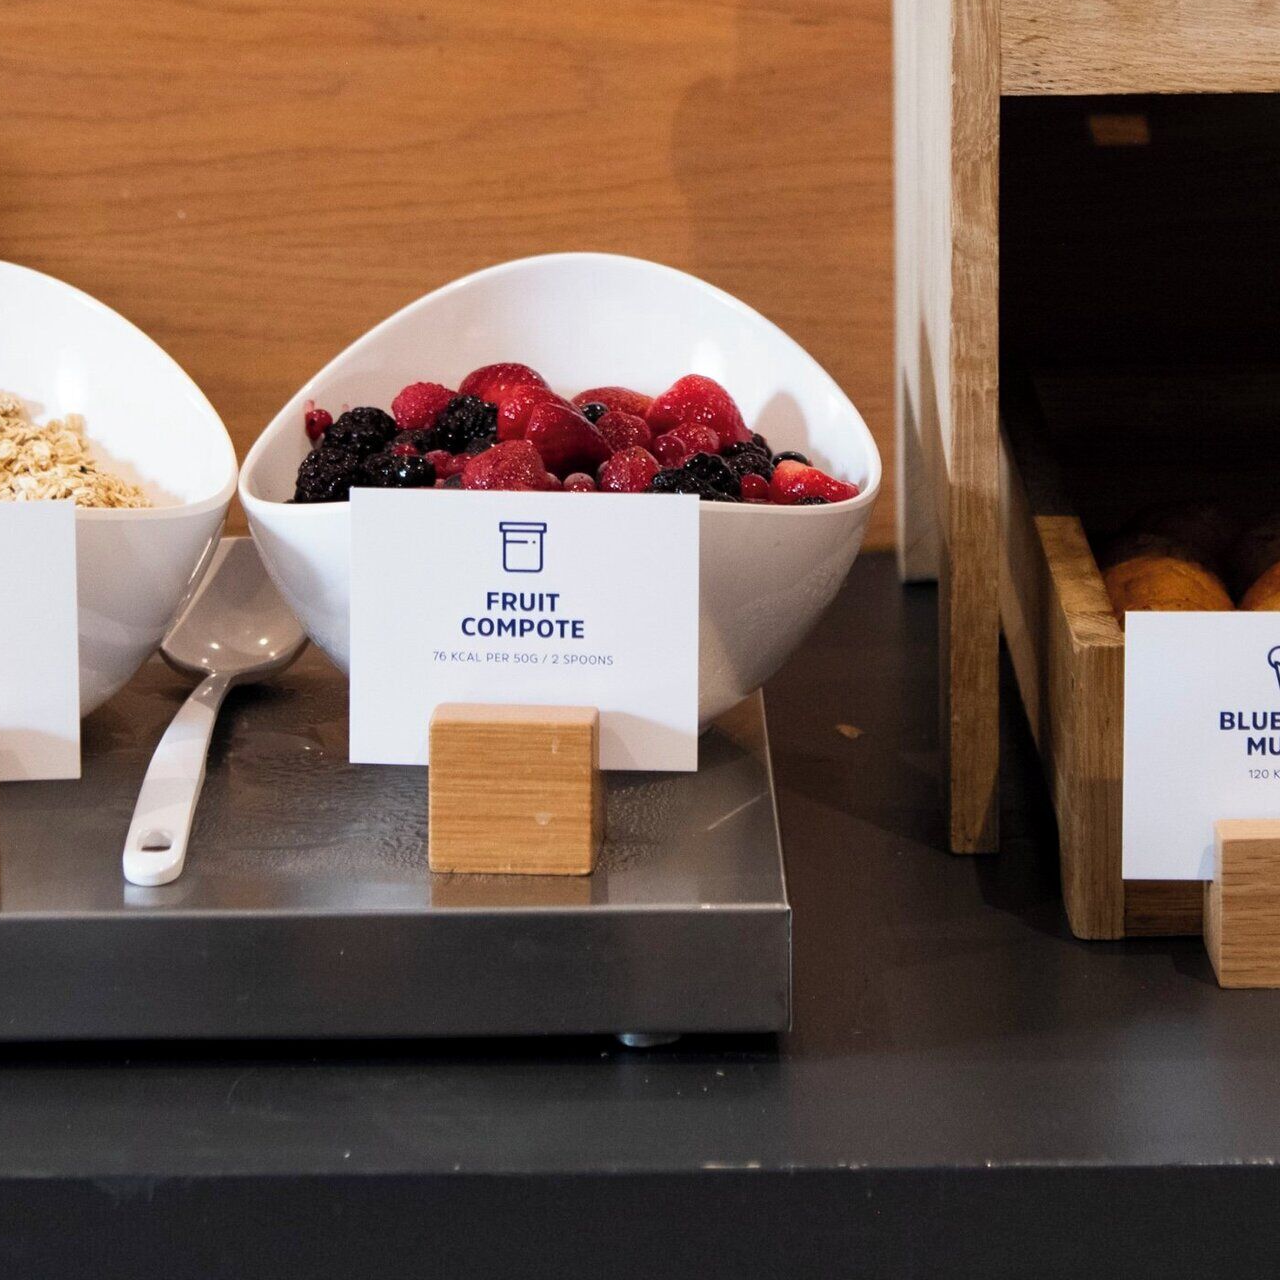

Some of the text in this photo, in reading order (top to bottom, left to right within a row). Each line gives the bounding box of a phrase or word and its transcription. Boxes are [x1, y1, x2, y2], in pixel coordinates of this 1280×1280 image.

[486, 591, 560, 612] FRUIT
[461, 617, 585, 639] COMPOTE
[432, 651, 447, 662] 76
[451, 651, 482, 663] KCAL
[486, 652, 510, 663] PER
[513, 653, 539, 664] 50G
[551, 654, 560, 664] 2
[563, 654, 614, 665] SPOONS
[1248, 769, 1270, 780] 120
